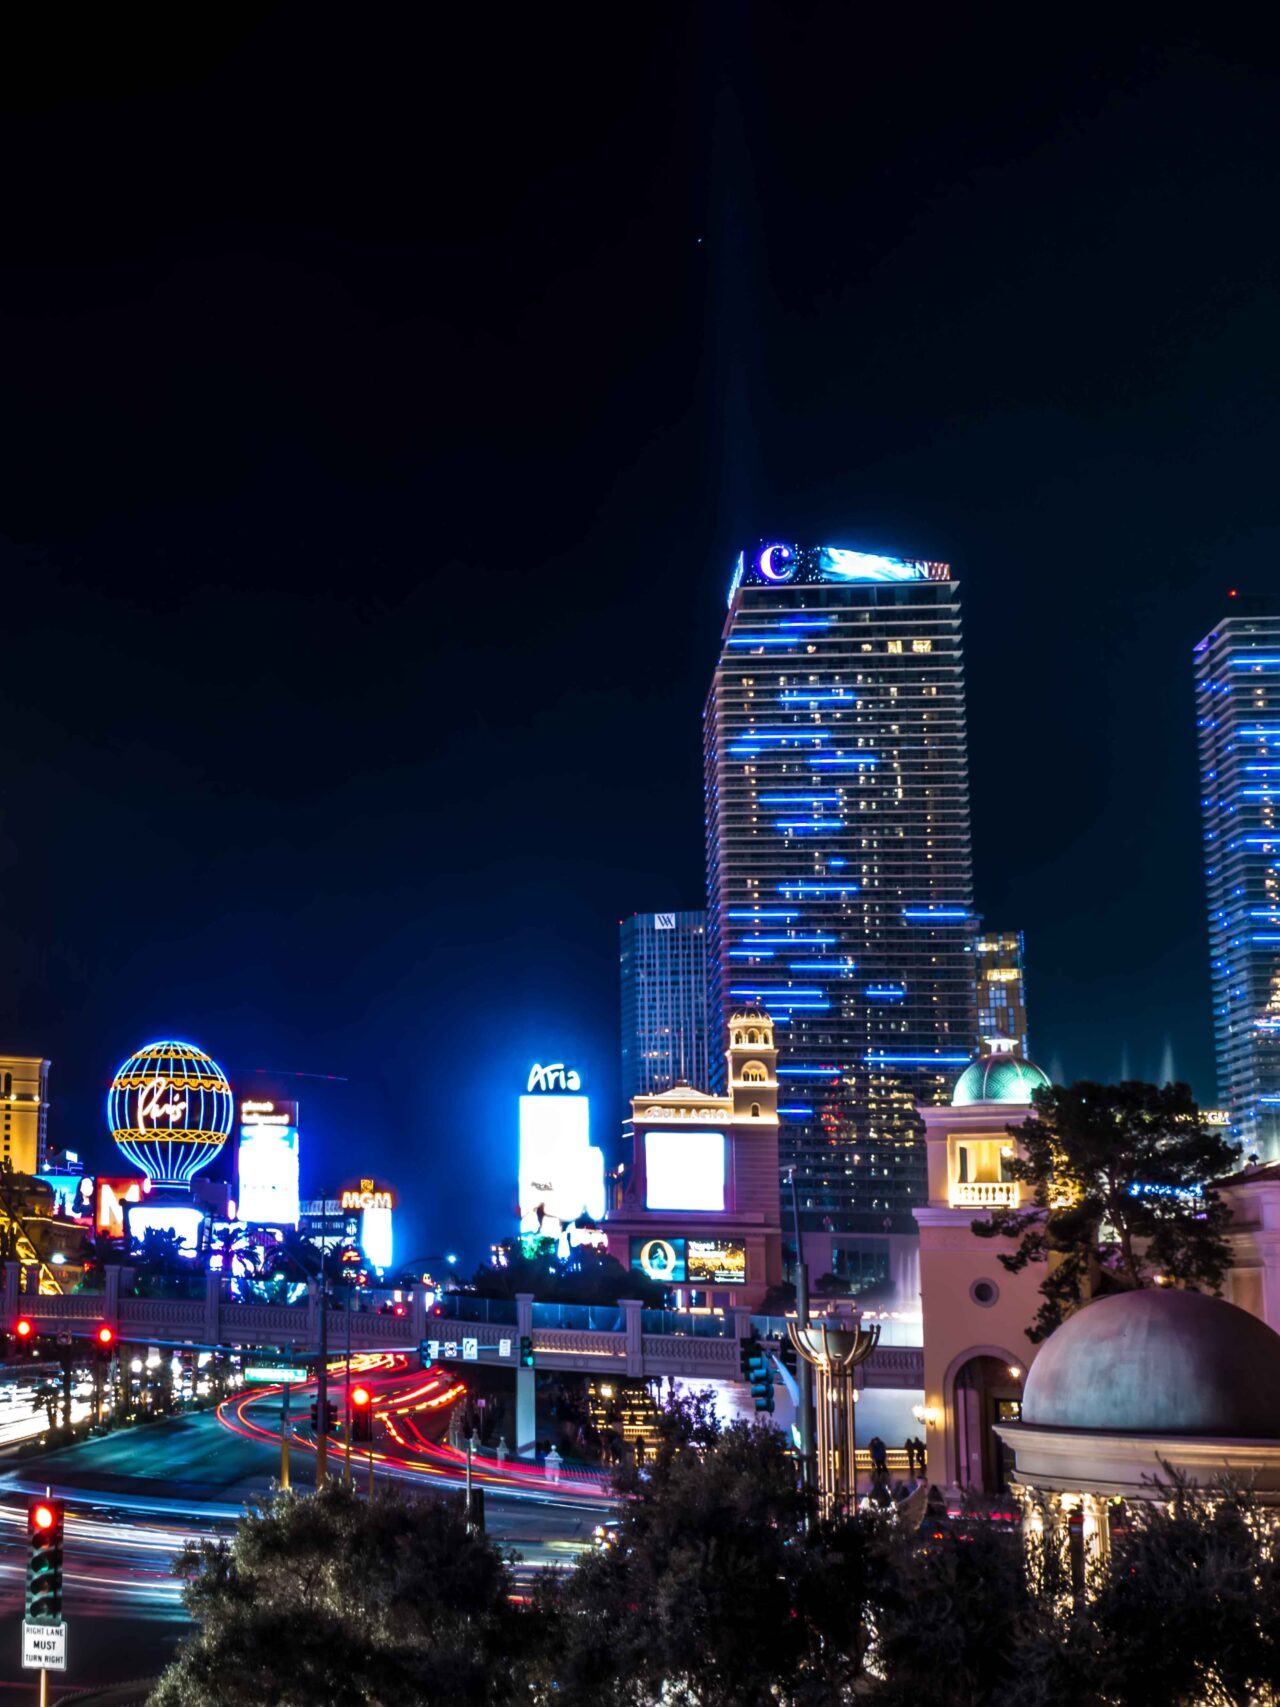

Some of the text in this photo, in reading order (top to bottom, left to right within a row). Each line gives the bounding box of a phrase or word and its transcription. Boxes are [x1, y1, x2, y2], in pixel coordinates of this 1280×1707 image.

[137, 1077, 187, 1135] Paris
[341, 1191, 393, 1210] MGM
[26, 1627, 63, 1637] RIGHT LANE
[33, 1640, 56, 1650] MUST
[26, 1654, 63, 1664] TURN RIGHT
